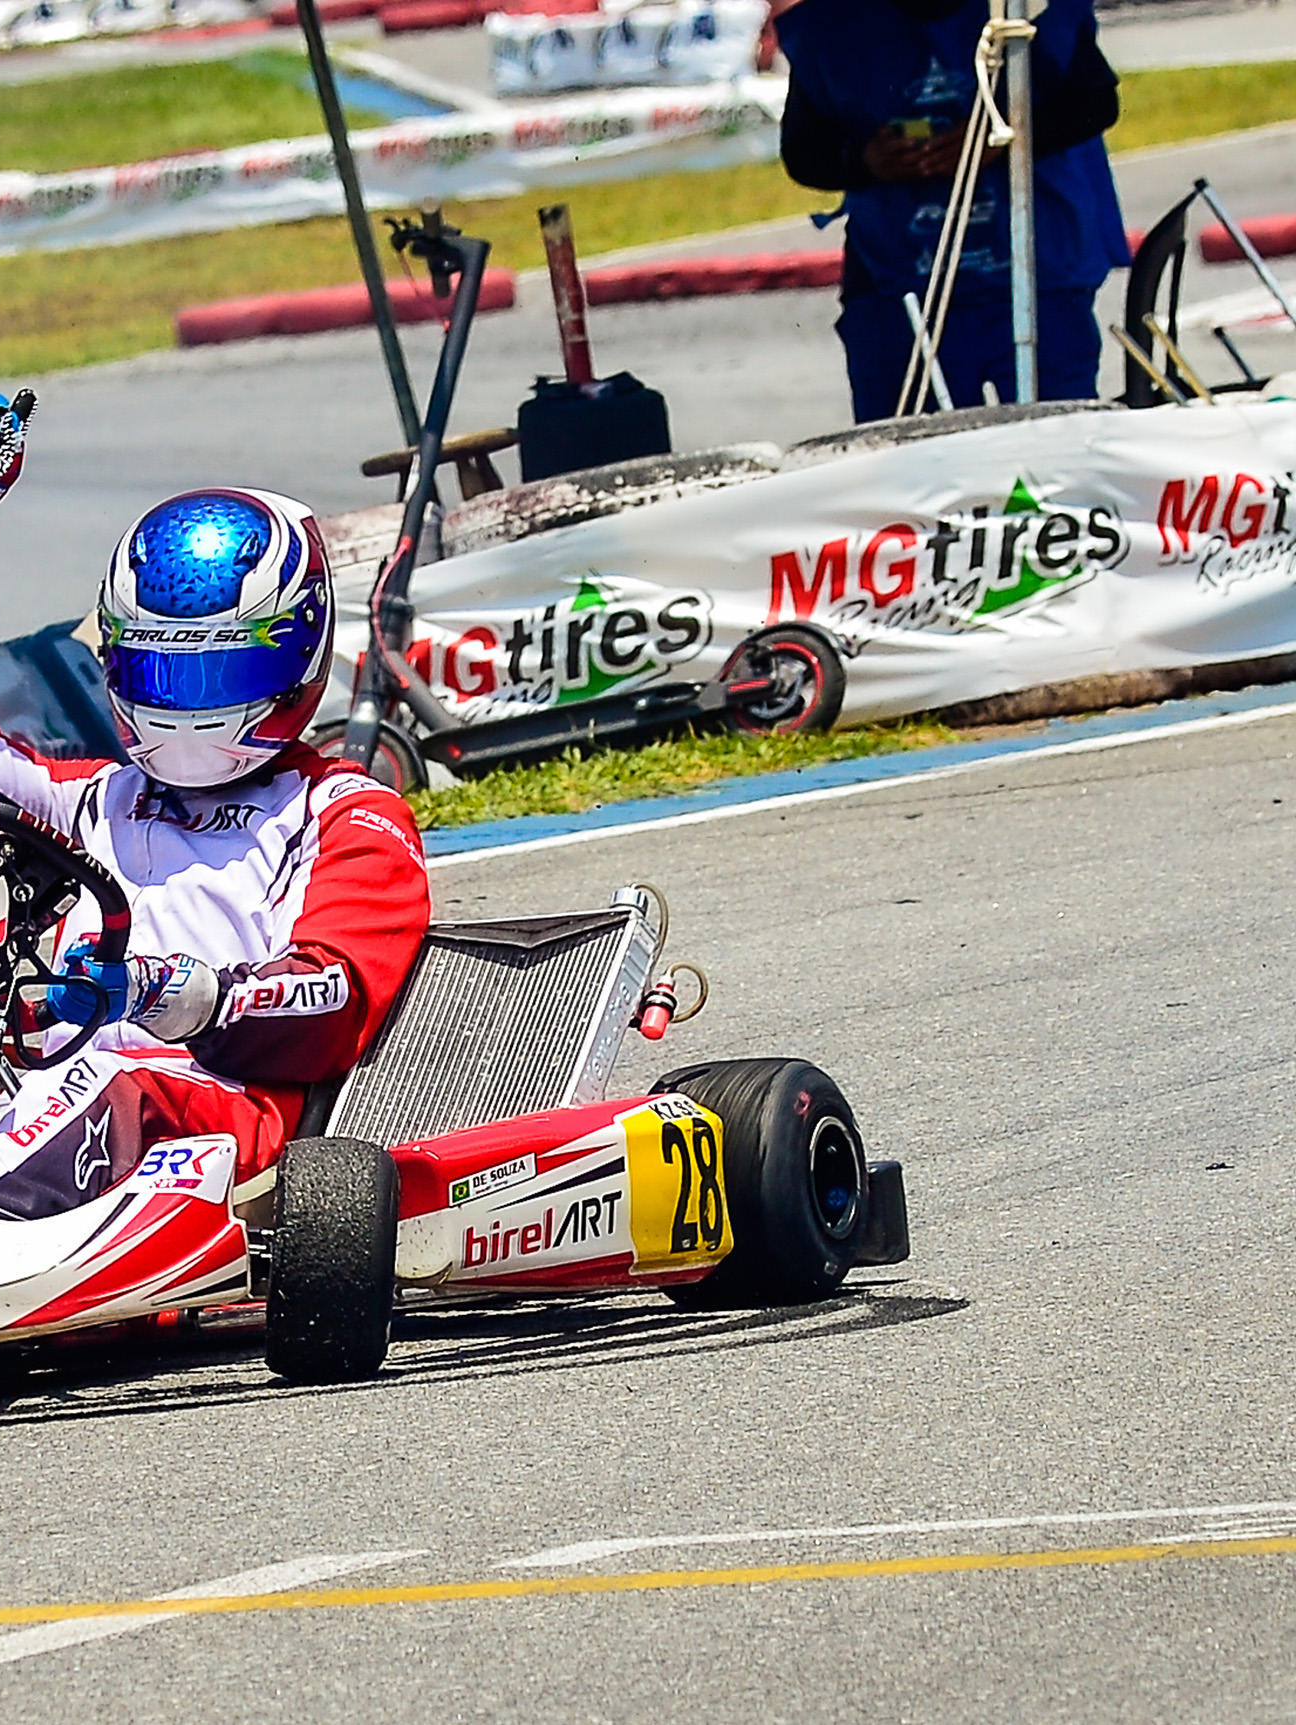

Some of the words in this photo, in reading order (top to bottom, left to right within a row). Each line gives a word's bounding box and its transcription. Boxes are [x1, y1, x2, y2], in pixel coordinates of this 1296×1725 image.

[765, 505, 1120, 626] MGtires
[119, 628, 210, 643] CARLOS
[212, 628, 253, 643] SG
[472, 1173, 487, 1188] DE
[490, 1160, 526, 1182] SOUZA
[661, 1117, 724, 1254] 28
[462, 1190, 623, 1269] birelART
